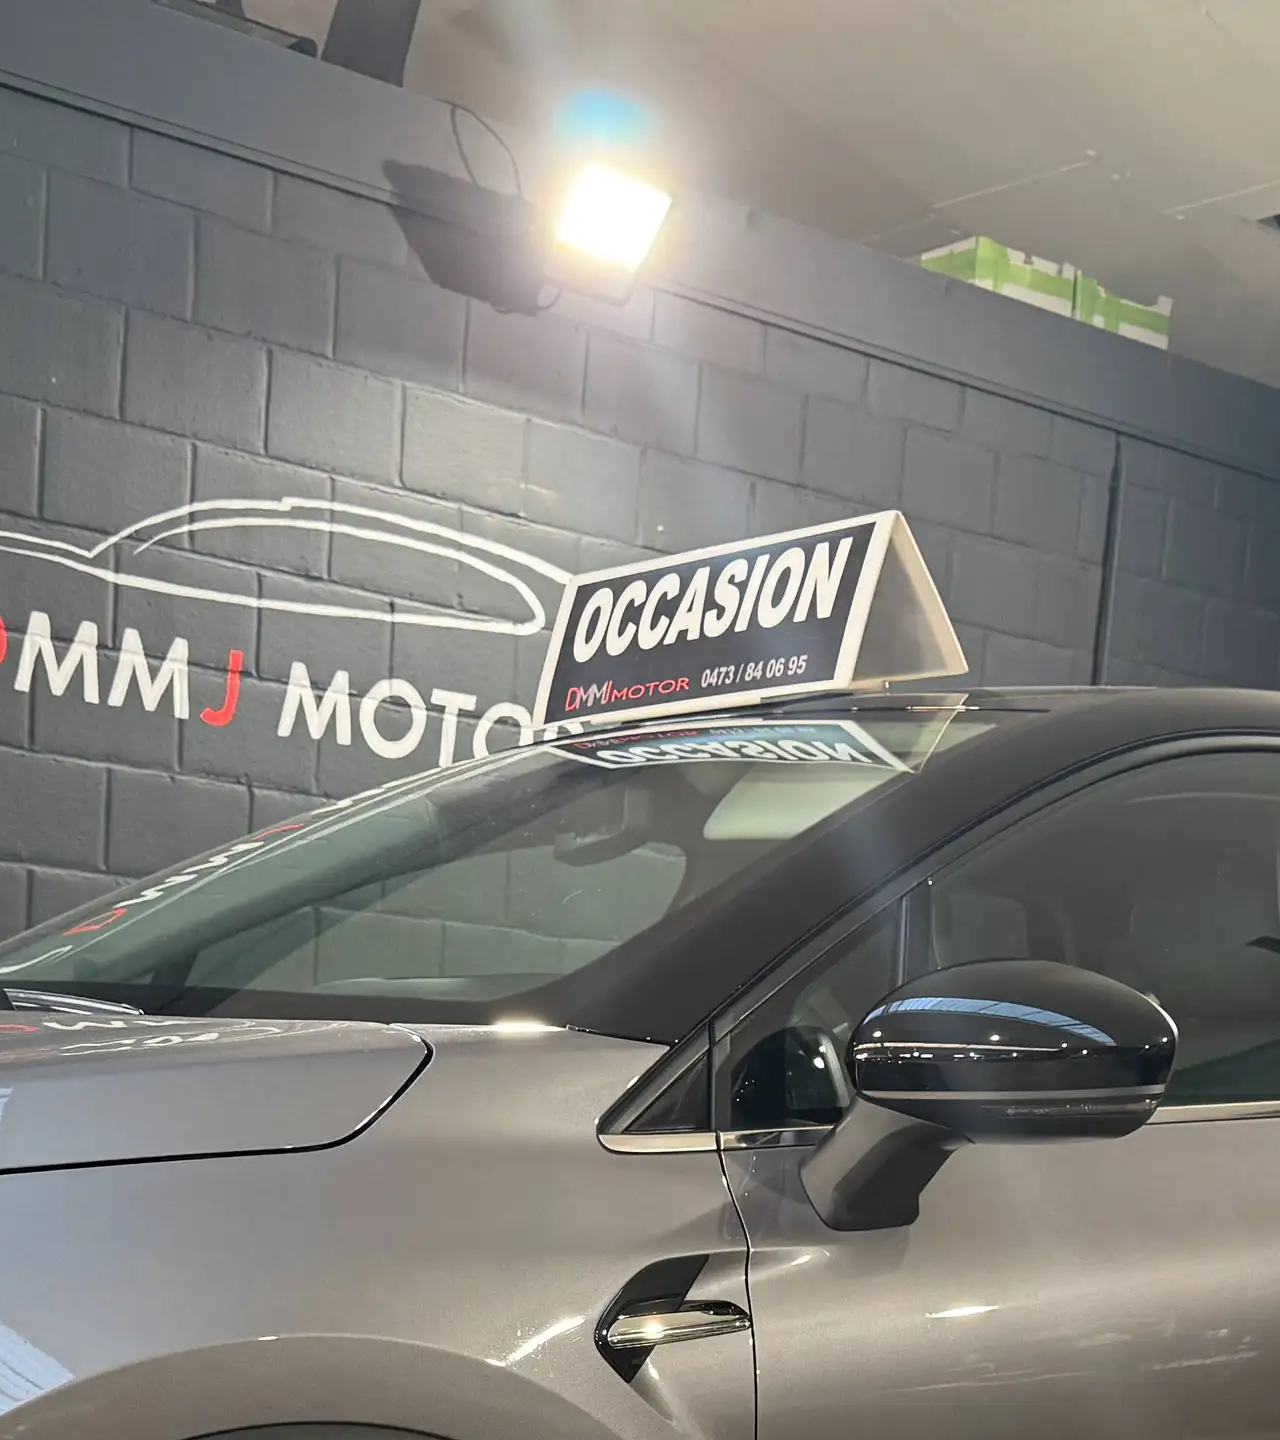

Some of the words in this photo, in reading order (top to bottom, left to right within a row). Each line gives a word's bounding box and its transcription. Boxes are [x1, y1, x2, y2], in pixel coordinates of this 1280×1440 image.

[573, 537, 854, 664] OCCASION
[700, 663, 734, 688] 0473
[744, 660, 763, 682] 84
[766, 657, 785, 678] 06
[787, 654, 809, 675] 95
